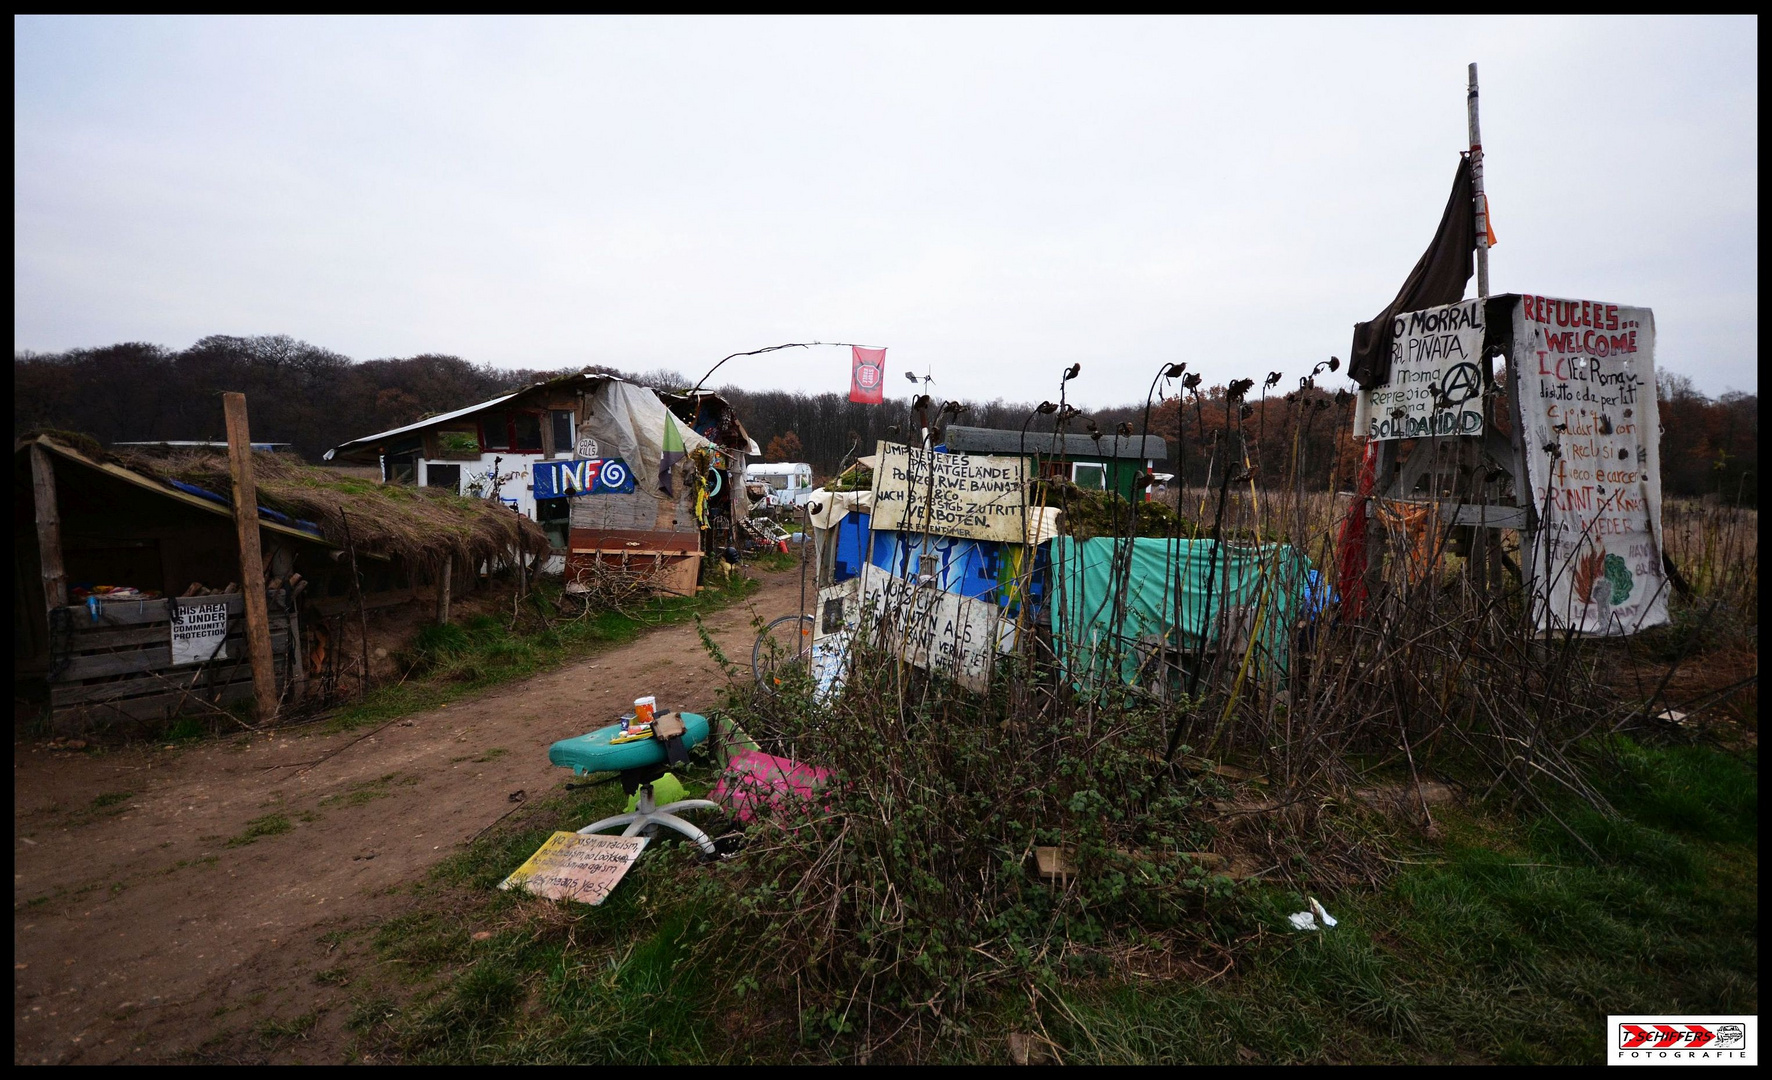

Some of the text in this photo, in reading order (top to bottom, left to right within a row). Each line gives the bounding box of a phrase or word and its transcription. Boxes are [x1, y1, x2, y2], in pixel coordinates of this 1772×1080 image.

[1544, 328, 1637, 357] WELCOME
[579, 440, 595, 448] COAL
[551, 459, 625, 495] INFO
[876, 491, 904, 502] NACH
[199, 604, 225, 613] AREA
[188, 613, 225, 624] UNDER
[174, 622, 225, 633] COMMUNITY
[174, 629, 225, 640] PROTECTION
